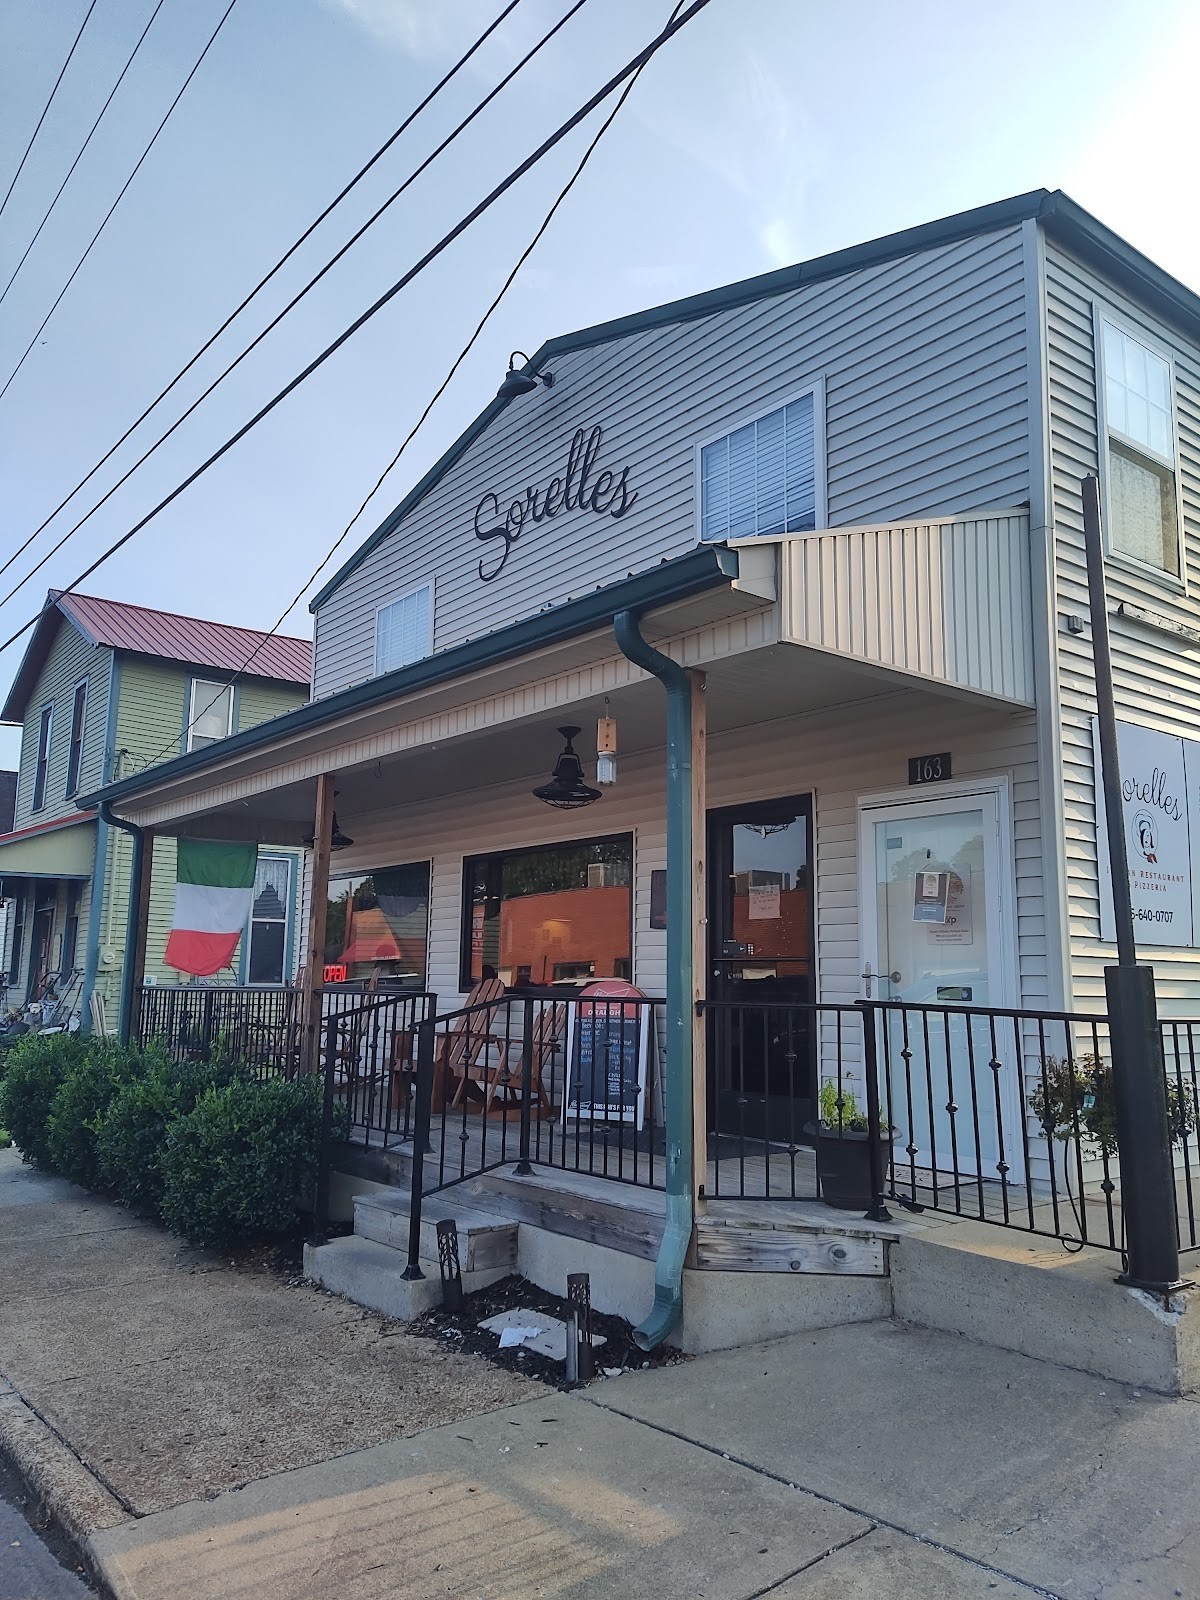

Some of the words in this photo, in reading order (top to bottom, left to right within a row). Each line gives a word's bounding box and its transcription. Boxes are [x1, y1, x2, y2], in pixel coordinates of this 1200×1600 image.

[474, 425, 639, 582] Sorelles
[915, 757, 942, 782] 163
[1122, 767, 1183, 821] orelles
[1140, 870, 1184, 883] RESTAURANT
[1134, 880, 1167, 892] PIZZERIA
[1130, 908, 1174, 923] 5-640-0707
[323, 965, 347, 982] OPEN
